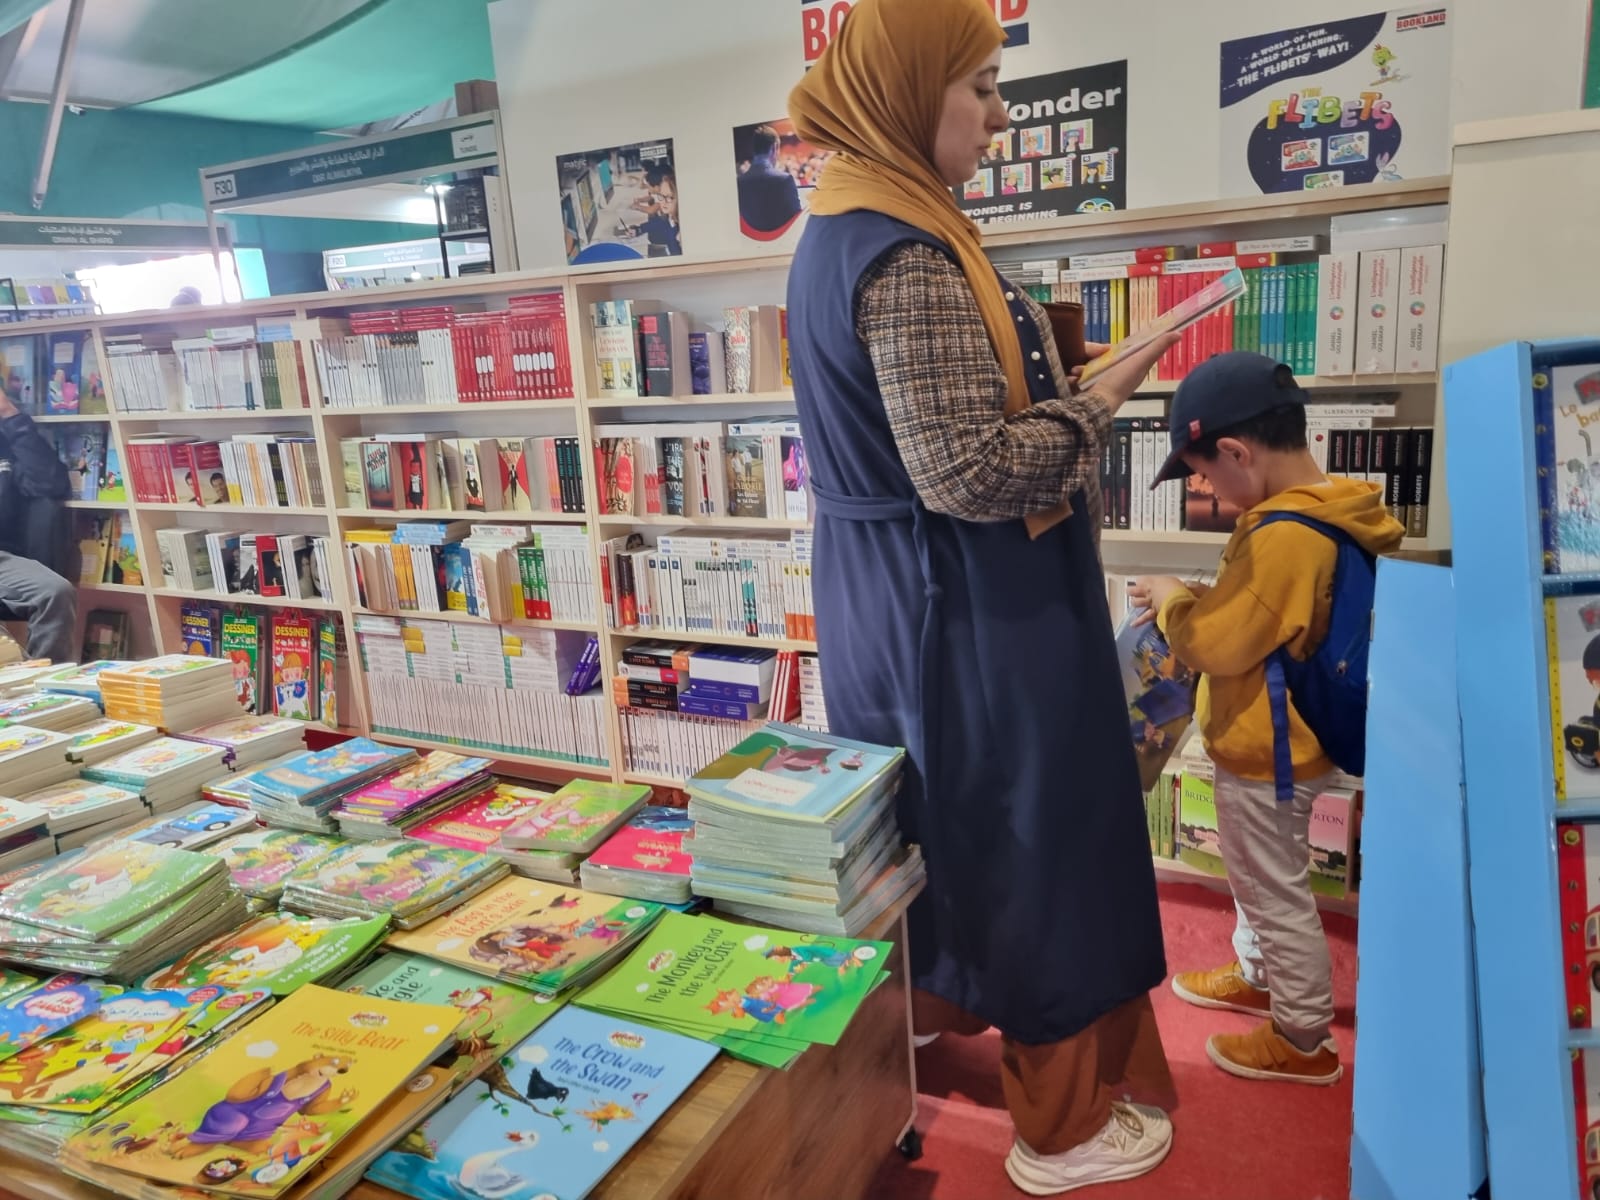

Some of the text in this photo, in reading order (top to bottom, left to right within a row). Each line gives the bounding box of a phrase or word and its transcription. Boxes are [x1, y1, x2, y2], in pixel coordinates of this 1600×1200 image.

[1396, 13, 1446, 29] BOOKLAND
[1261, 40, 1291, 56] WORLD
[1236, 72, 1259, 88] THE
[1317, 41, 1350, 60] WAY!
[1249, 54, 1279, 70] WORLD
[1266, 91, 1394, 130] FLIBETS
[213, 179, 234, 195] F30
[1018, 201, 1033, 210] IS
[224, 623, 256, 634] DESSINER
[275, 626, 309, 637] DESSINER
[1185, 790, 1213, 804] BRIDG
[1314, 813, 1344, 825] RTON
[455, 911, 484, 925] Ass
[704, 941, 737, 962] Cats
[645, 927, 723, 1003] The Monkey and
[694, 964, 718, 981] two
[393, 965, 420, 985] and
[387, 981, 423, 1002] gle
[679, 980, 703, 997] the
[291, 1022, 320, 1037] The
[320, 1026, 358, 1046] Silly
[357, 1031, 406, 1051] Bear
[554, 1037, 665, 1079] The Crow and
[550, 1059, 578, 1075] the
[577, 1063, 632, 1092] Swan
